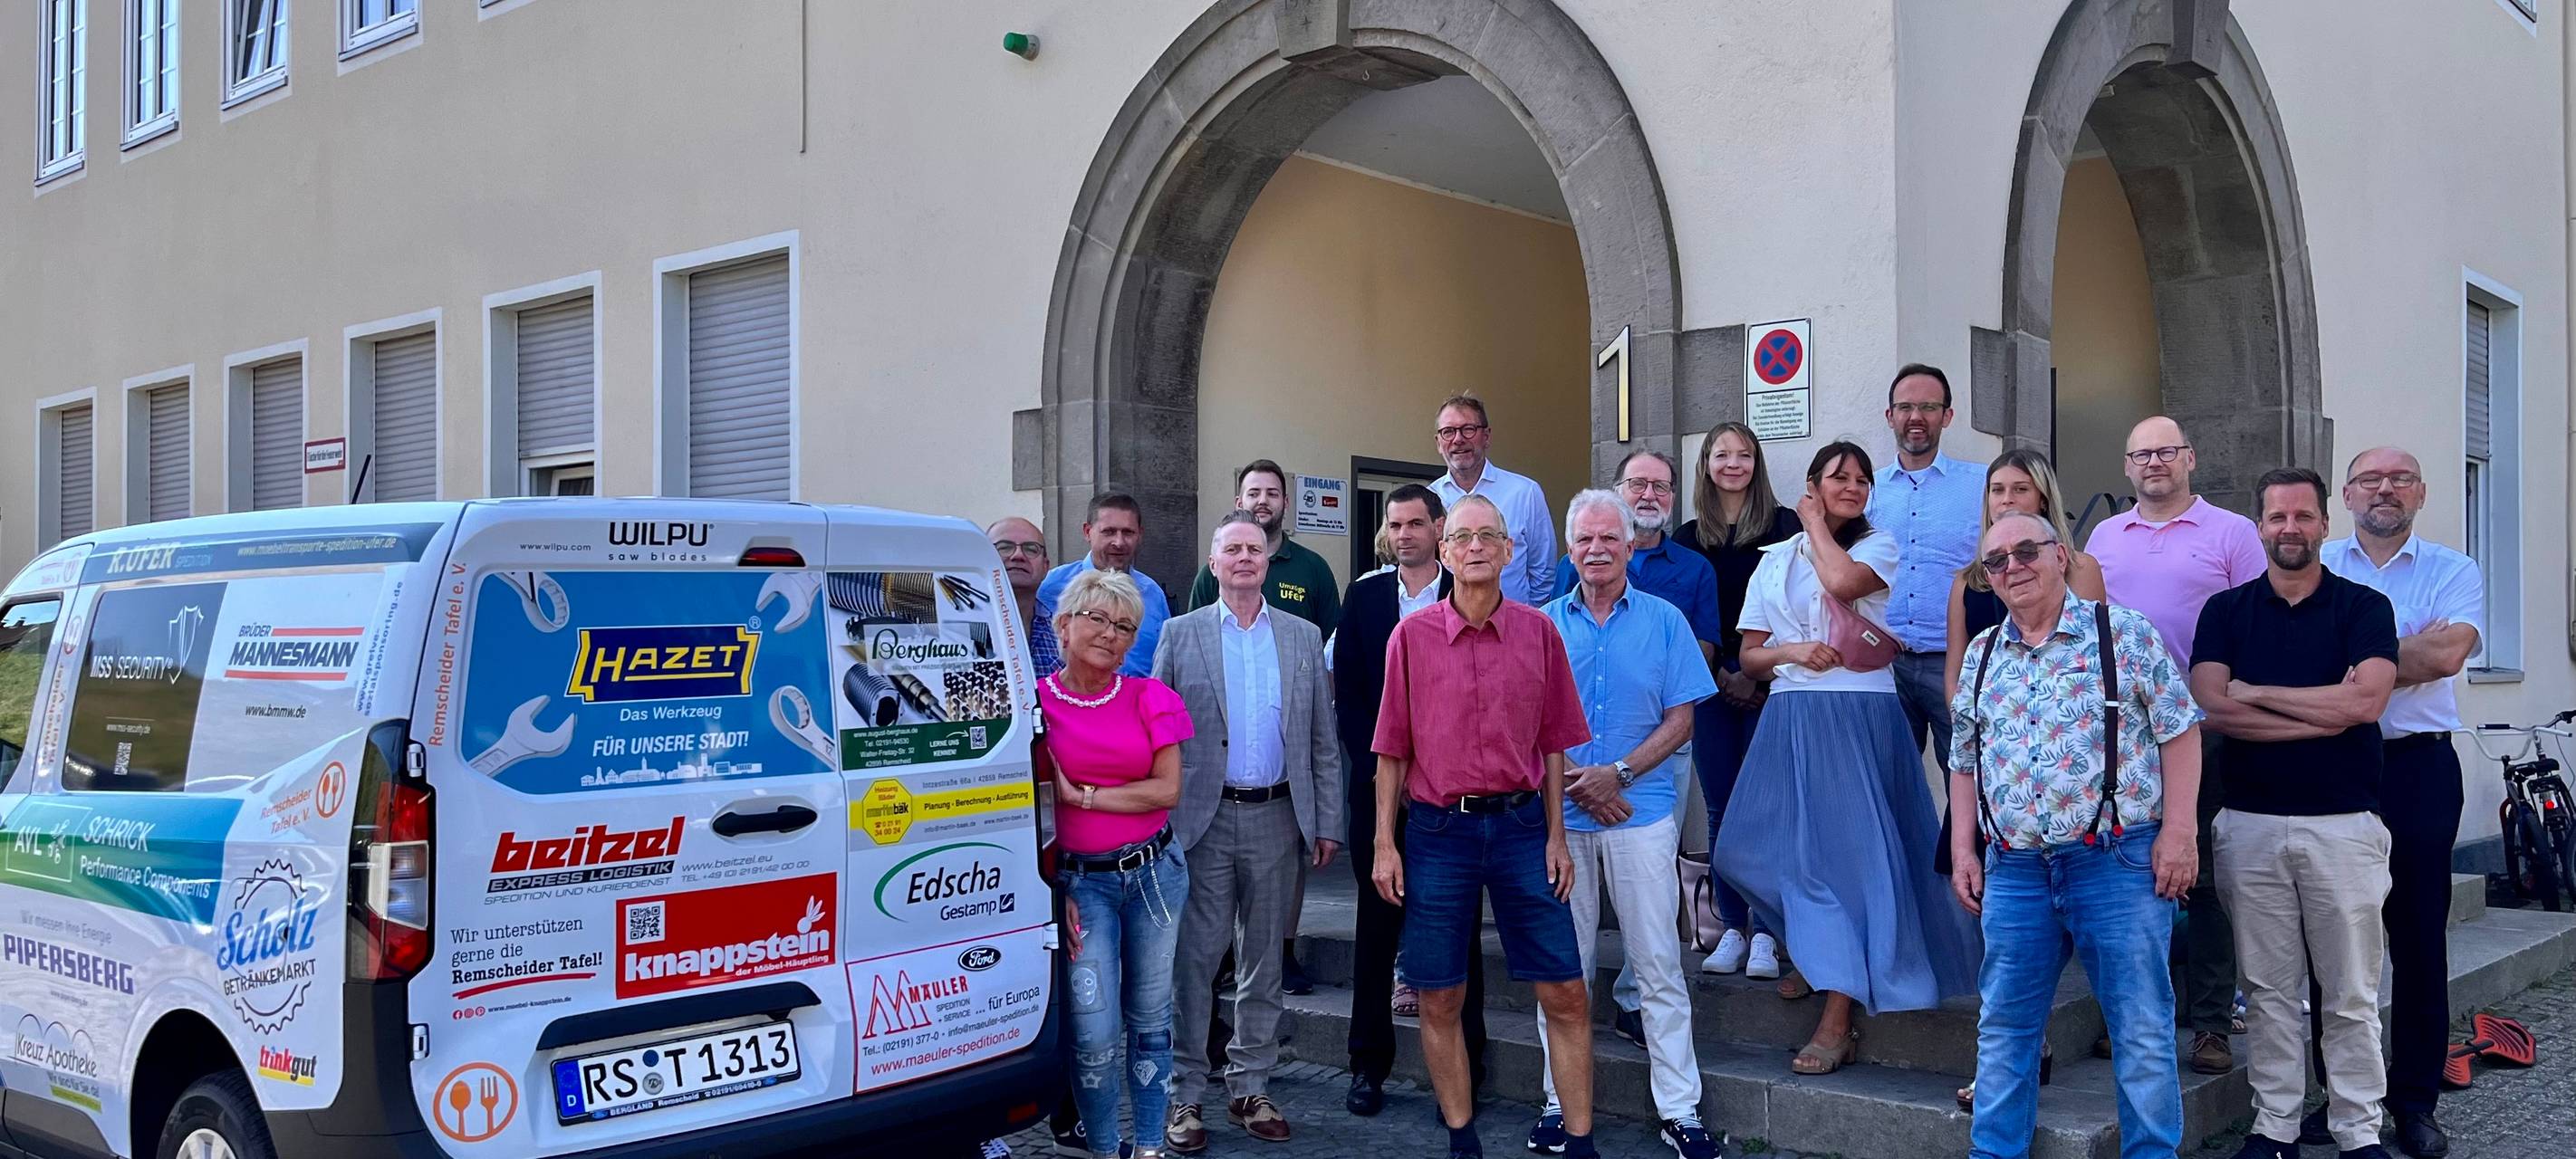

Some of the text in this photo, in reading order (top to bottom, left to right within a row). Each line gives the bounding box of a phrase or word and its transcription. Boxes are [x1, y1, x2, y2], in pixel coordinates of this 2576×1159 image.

[1597, 324, 1630, 443] 1
[1303, 476, 1341, 492] EINGANG
[238, 535, 397, 557] www.moebeltransporte-spedition-ufer.de
[520, 542, 591, 552] www.wilpu.com
[608, 552, 706, 562] saw blades
[1280, 589, 1304, 602] Ufer
[238, 622, 272, 637] BRÜDER
[993, 569, 1015, 650] Remscheider
[1011, 654, 1024, 685] Tafel
[228, 641, 360, 667] MANNESMANN
[872, 627, 968, 664] Berghaus
[428, 642, 456, 746] Remscheider
[444, 599, 463, 635] Tafel
[590, 645, 741, 684] HAZET
[245, 704, 306, 719] www.bmmw.de
[620, 705, 723, 722] Das Werkzeug
[592, 731, 750, 757] FÜR UNSERE STADT!
[261, 788, 312, 819] Remscheider
[924, 790, 1029, 810] Planung Berechnung Ausführung
[14, 815, 157, 857] AVL SCHRICK
[271, 814, 292, 834] Tafel
[490, 815, 686, 874] beitzel
[80, 855, 211, 899] Performance Components
[490, 861, 672, 892] EXPRESS LOGISTIK
[681, 854, 774, 872] www.beitzel.eu
[703, 871, 722, 880] +49
[738, 864, 780, 876] 2191/42
[781, 862, 794, 870] 00
[796, 860, 810, 868] 00
[484, 876, 672, 905] SPEDITION UND KURIERDIENST
[907, 861, 1002, 905] Edscha
[940, 899, 997, 921] Gestamp
[217, 897, 319, 972] Scholz
[451, 918, 583, 944] Wir unterstützen
[4, 934, 134, 995] PIPERSBERG
[451, 943, 523, 968] gerne die
[452, 952, 603, 985] Remscheider Tafel!
[624, 928, 831, 982] knappstein
[735, 954, 830, 977] der Möbel-Häuptling
[968, 949, 995, 967] Ford
[224, 958, 317, 996] GETRÄNKEMARKT
[487, 996, 572, 1013] www.moebel-knappstein.de
[936, 998, 971, 1012] SPEDITION
[943, 1009, 971, 1023] SERVICE
[988, 996, 1004, 1011] für
[1005, 985, 1041, 1006] Europa
[863, 1004, 1039, 1057] Tel.: (02191) 377-0 info@maeuler-spedition.de
[16, 1032, 98, 1078] Kreuz Apotheke
[259, 1044, 317, 1083] trinkgut
[871, 1026, 1021, 1076] www.maeuler-spedition.de
[566, 1030, 791, 1107] D RS T 1313
[610, 1101, 654, 1116] BERGLAND
[658, 1092, 700, 1106] Remscheid
